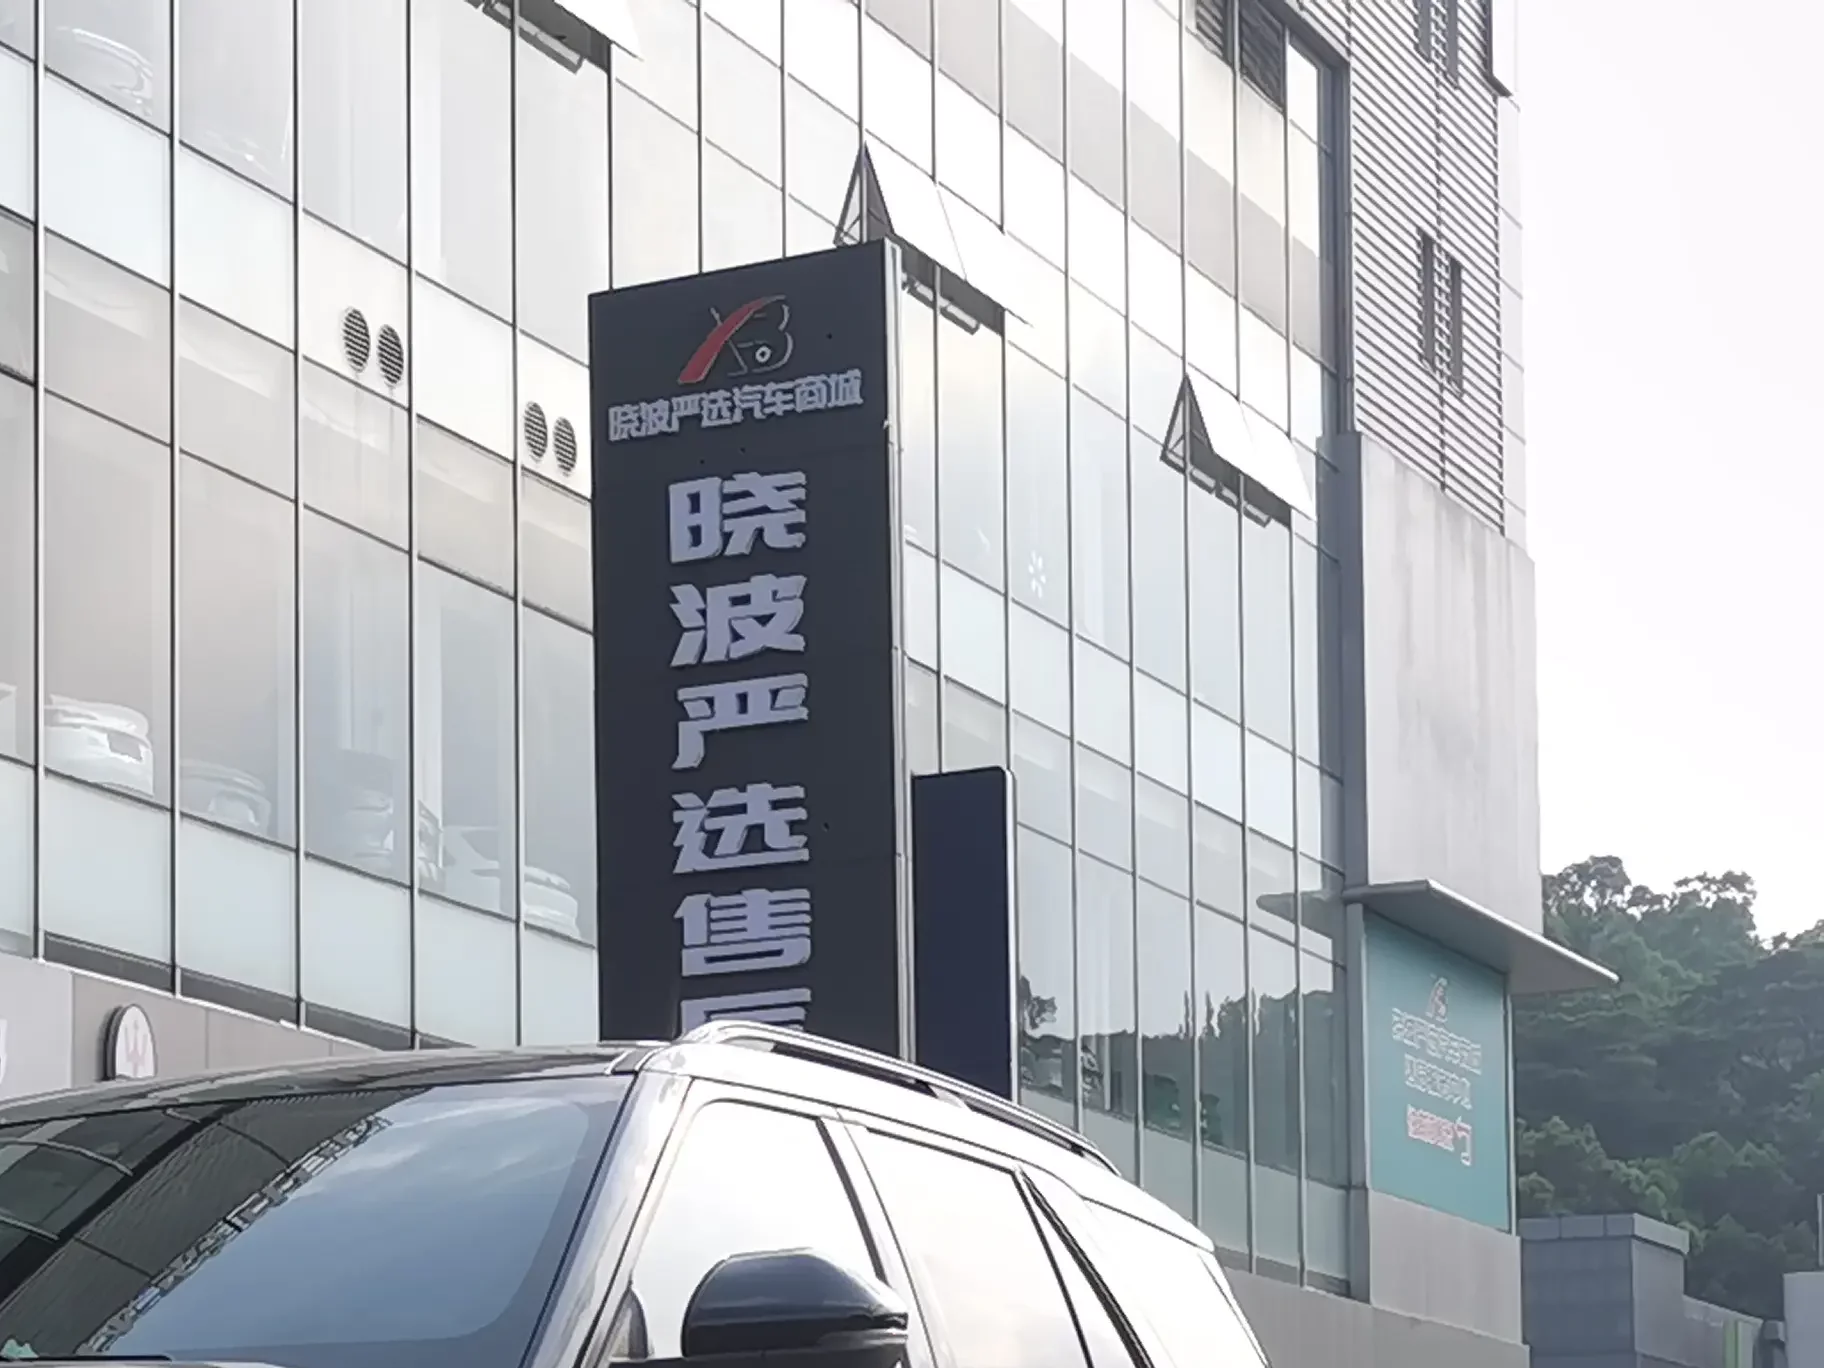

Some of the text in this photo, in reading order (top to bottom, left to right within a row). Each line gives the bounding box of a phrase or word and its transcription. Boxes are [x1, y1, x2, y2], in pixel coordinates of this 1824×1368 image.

[607, 368, 864, 442] 晓波严选汽车商城
